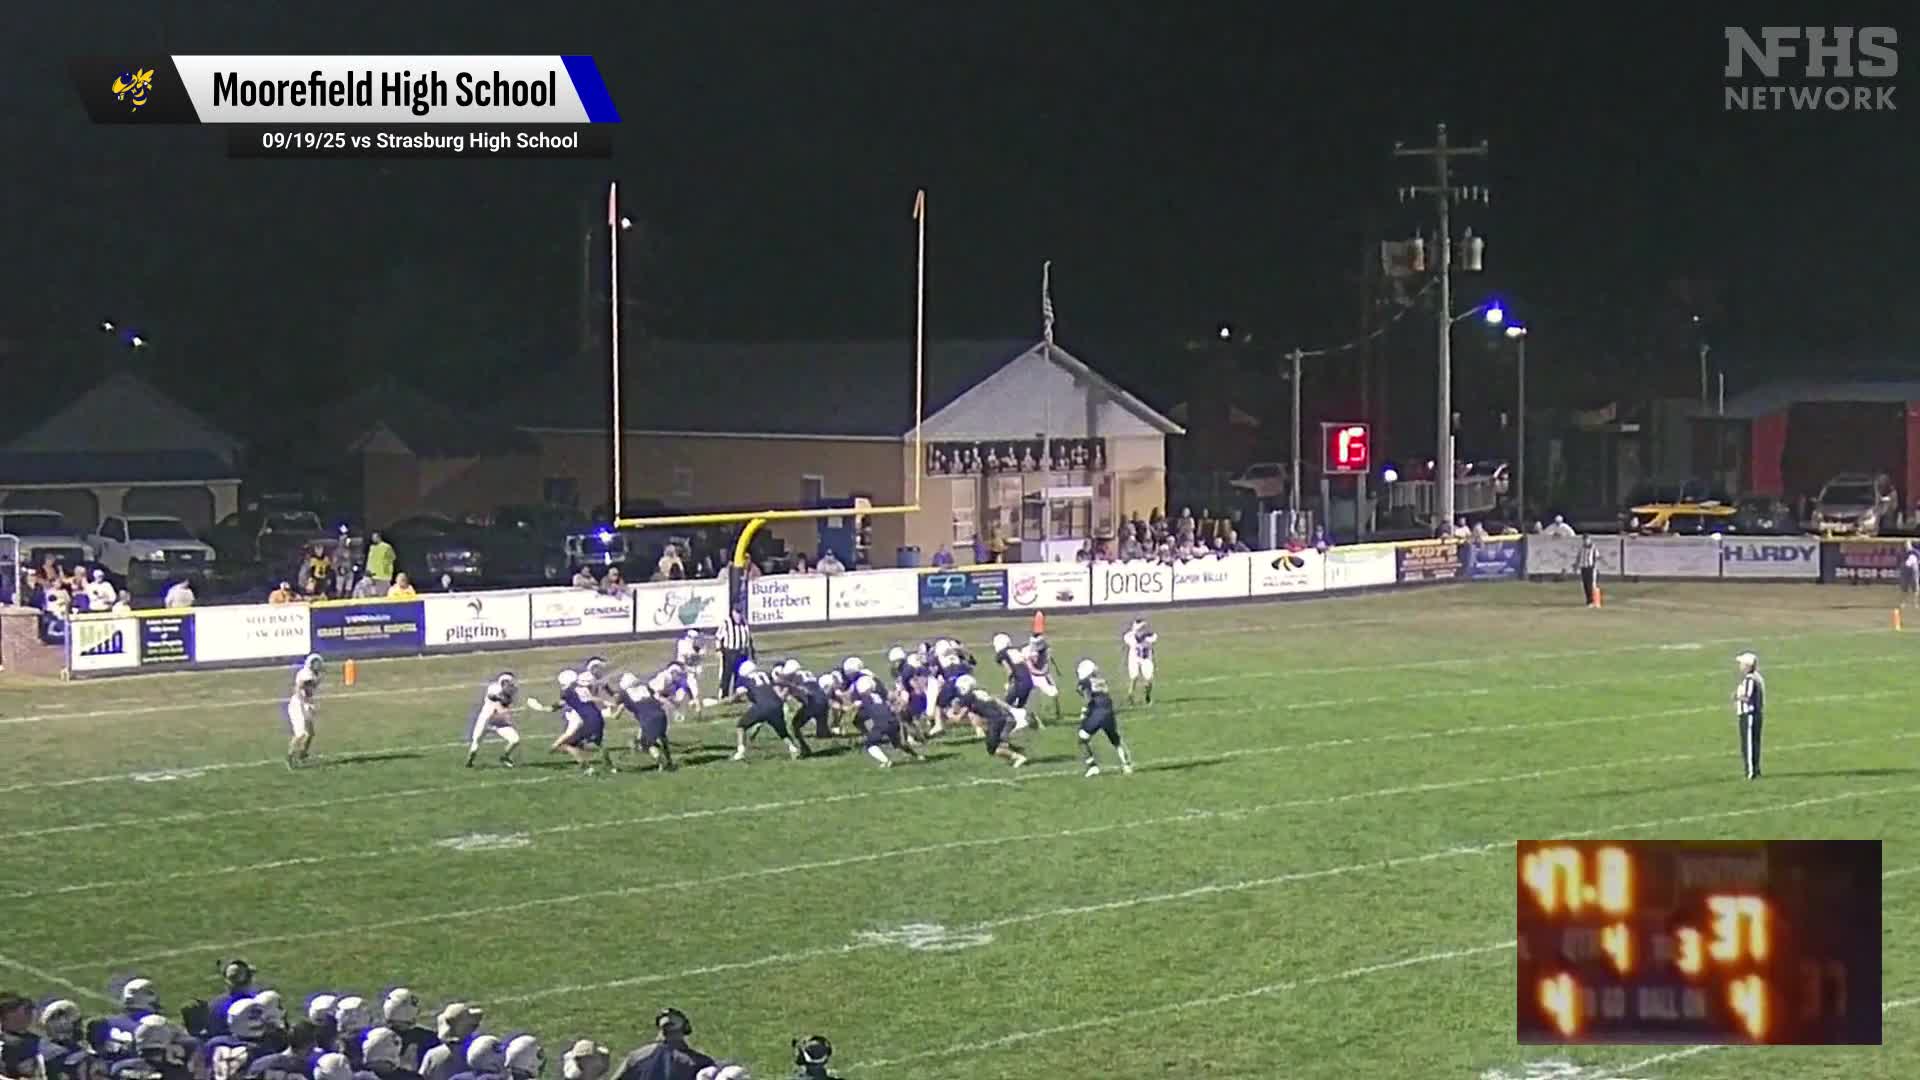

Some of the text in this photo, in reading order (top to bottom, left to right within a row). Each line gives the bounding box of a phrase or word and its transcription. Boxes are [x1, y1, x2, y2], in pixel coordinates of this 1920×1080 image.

[1724, 545, 1816, 562] HARDY
[751, 582, 790, 596] Burke
[1103, 569, 1163, 600] Jones
[762, 593, 811, 608] Herbert
[751, 610, 784, 623] Bank
[1708, 895, 1767, 960] 37
[1602, 923, 1630, 972] 4
[1677, 928, 1702, 974] 3
[1540, 973, 1575, 1036] 4
[1729, 973, 1765, 1038] 4
